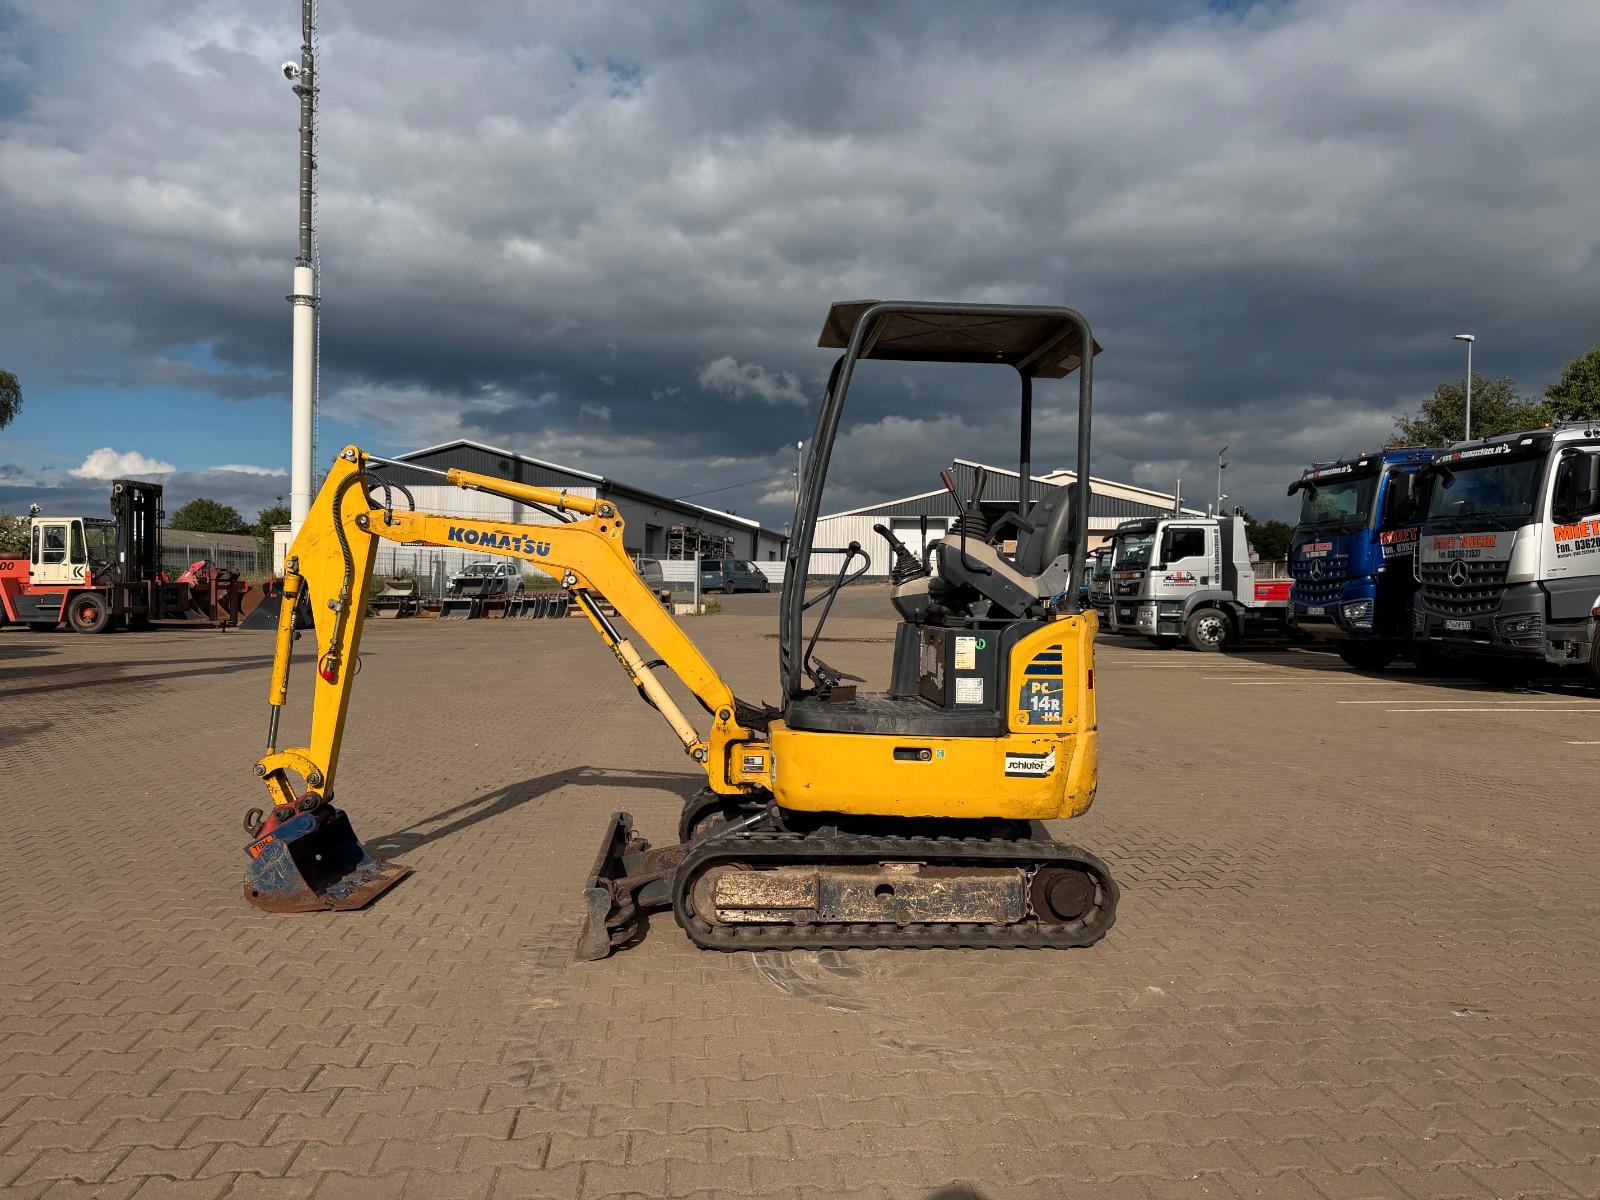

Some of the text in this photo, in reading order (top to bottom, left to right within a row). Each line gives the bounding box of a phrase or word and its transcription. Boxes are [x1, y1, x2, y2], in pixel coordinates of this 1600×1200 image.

[1380, 527, 1417, 545] MIET
[1554, 521, 1600, 541] MIET
[448, 526, 551, 556] KOMATSU
[1556, 544, 1573, 554] Fon.
[1031, 682, 1049, 694] PC
